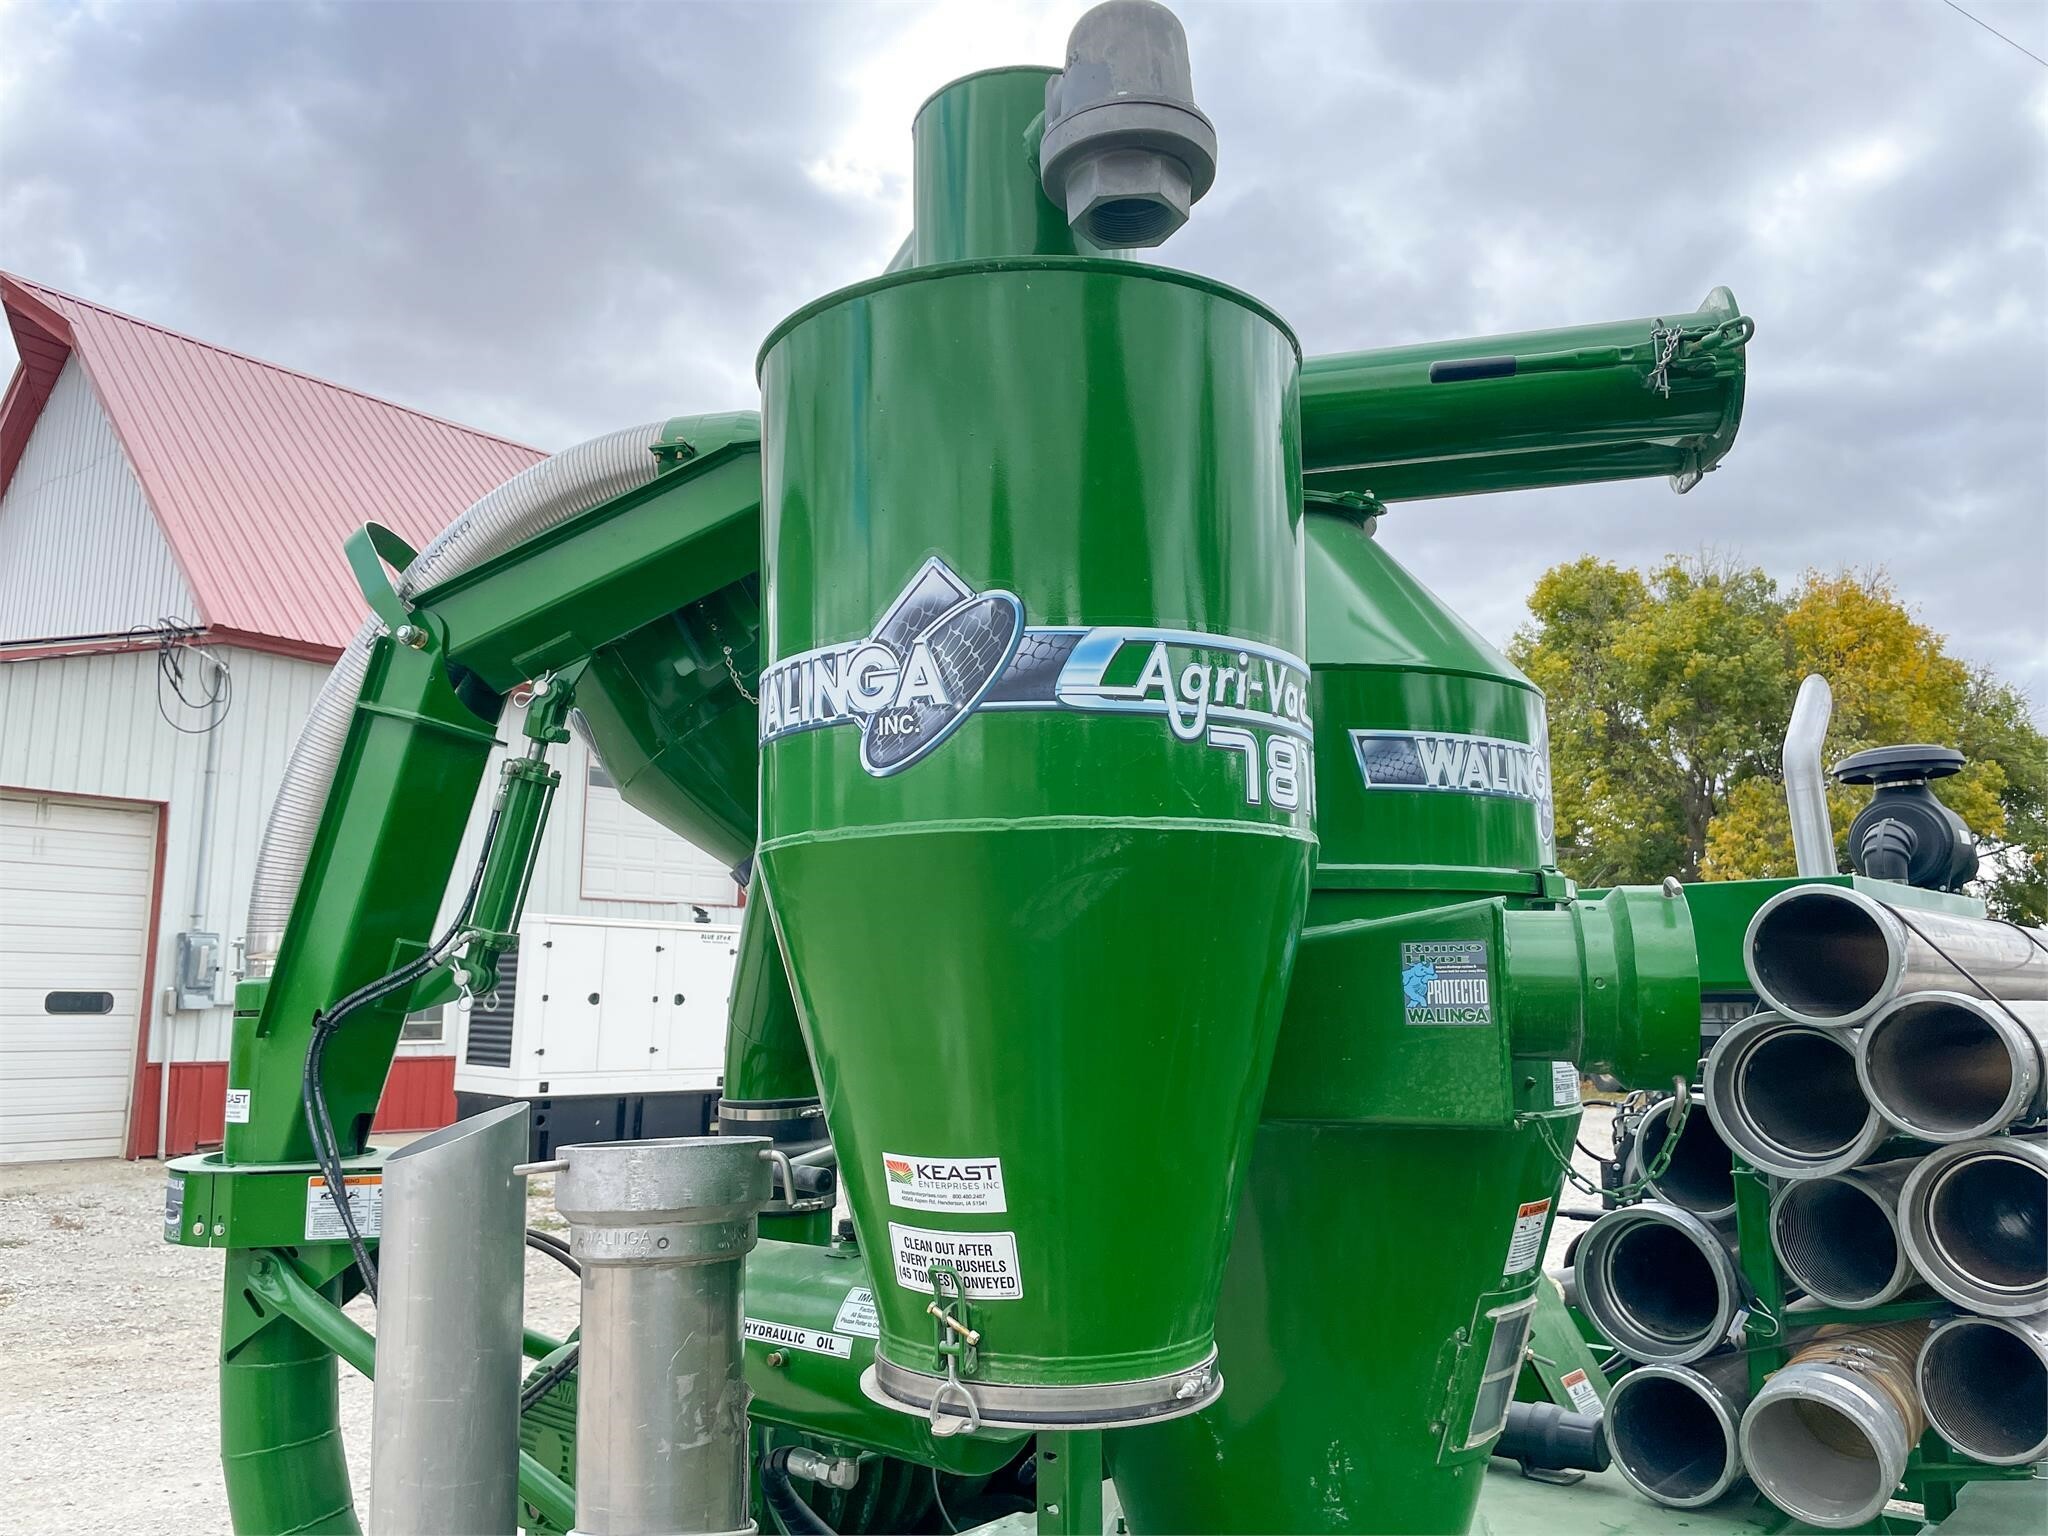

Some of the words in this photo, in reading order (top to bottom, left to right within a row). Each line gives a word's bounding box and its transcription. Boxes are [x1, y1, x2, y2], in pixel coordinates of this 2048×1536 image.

[878, 716, 920, 736] INC.
[1415, 737, 1547, 800] WALING
[1404, 943, 1483, 954] RHINO
[1404, 953, 1470, 965] HYDE
[1427, 979, 1488, 1005] PROTECTED
[1405, 1006, 1490, 1024] WALINGA
[916, 1164, 998, 1181] KEAST
[918, 1180, 980, 1190] ENTERPRISES
[983, 1181, 1000, 1190] INC
[903, 1236, 933, 1253] CLEAN
[935, 1241, 955, 1255] OUT
[958, 1243, 993, 1257] AFTER
[900, 1251, 927, 1267] EVERY
[955, 1260, 1007, 1273] BUSHELS
[899, 1265, 912, 1280] (45
[960, 1275, 1016, 1289] ONVEYED
[745, 1321, 806, 1345] HYDRAULIC
[816, 1335, 835, 1351] OIL
